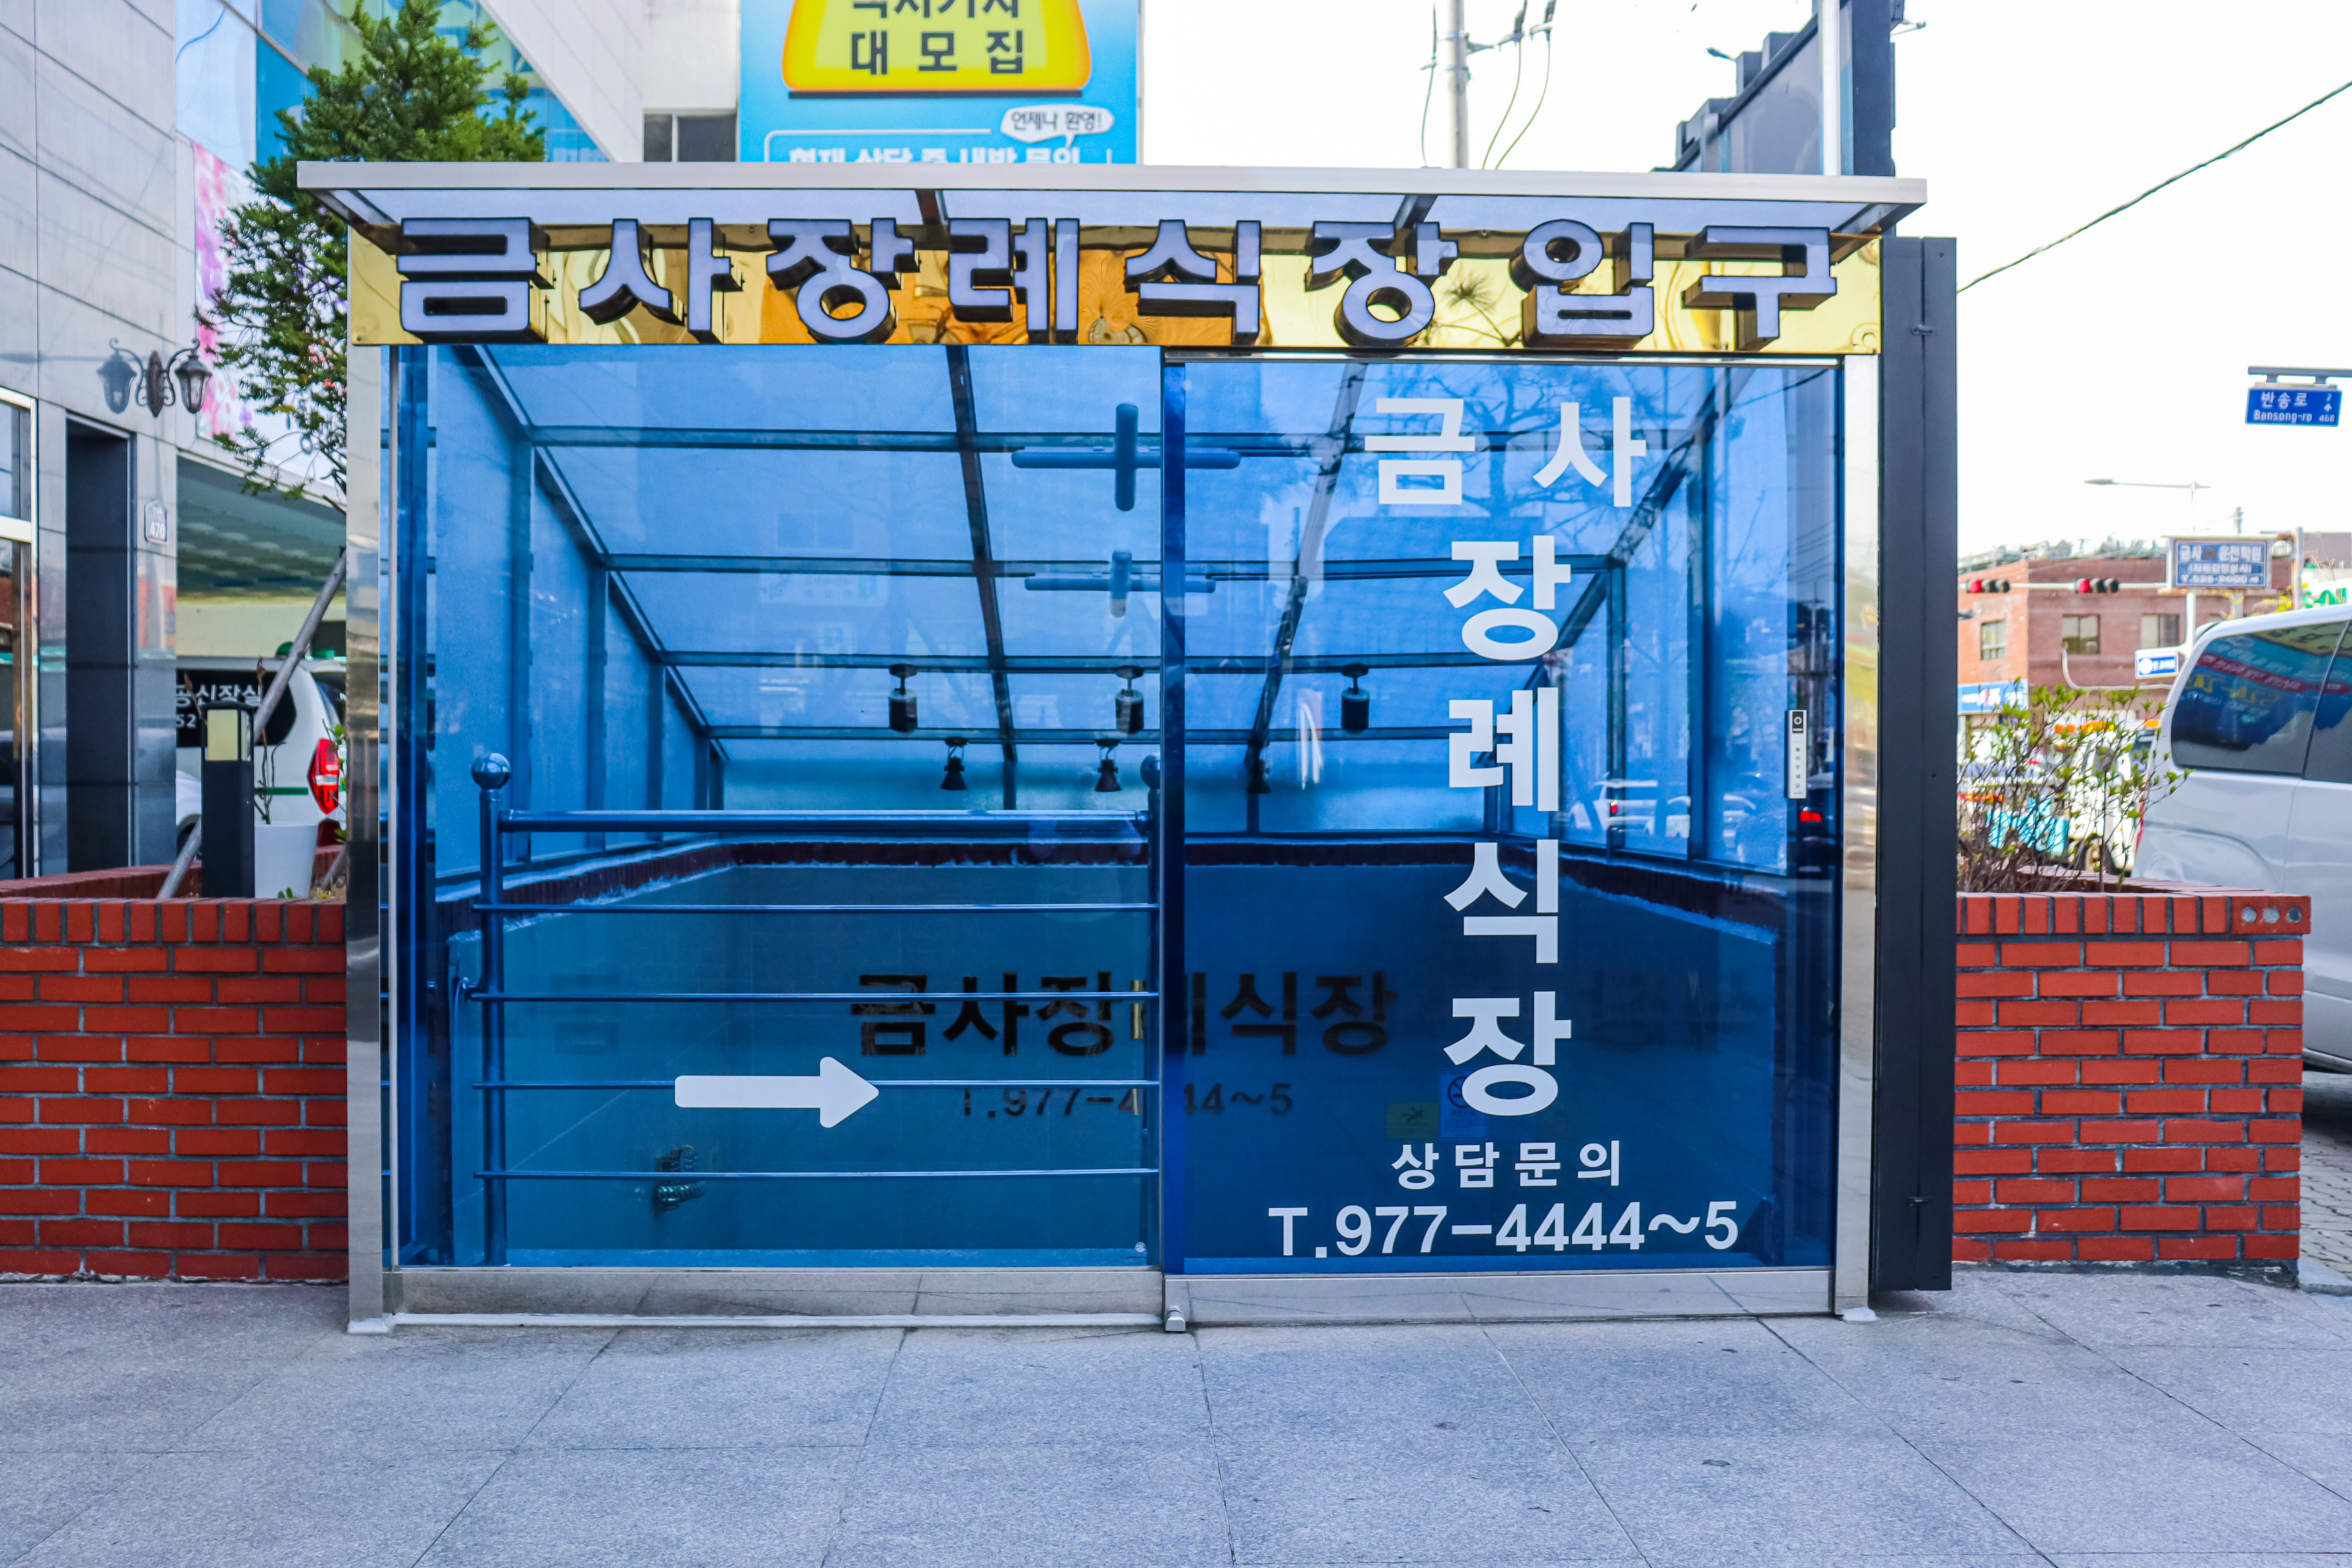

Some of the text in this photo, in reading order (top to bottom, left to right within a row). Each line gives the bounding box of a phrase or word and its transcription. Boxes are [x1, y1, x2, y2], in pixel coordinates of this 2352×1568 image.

[1011, 111, 1058, 131] 언제나
[2261, 392, 2308, 410] 반송로
[2254, 409, 2312, 423] Bansong-ro
[150, 521, 165, 539] 470
